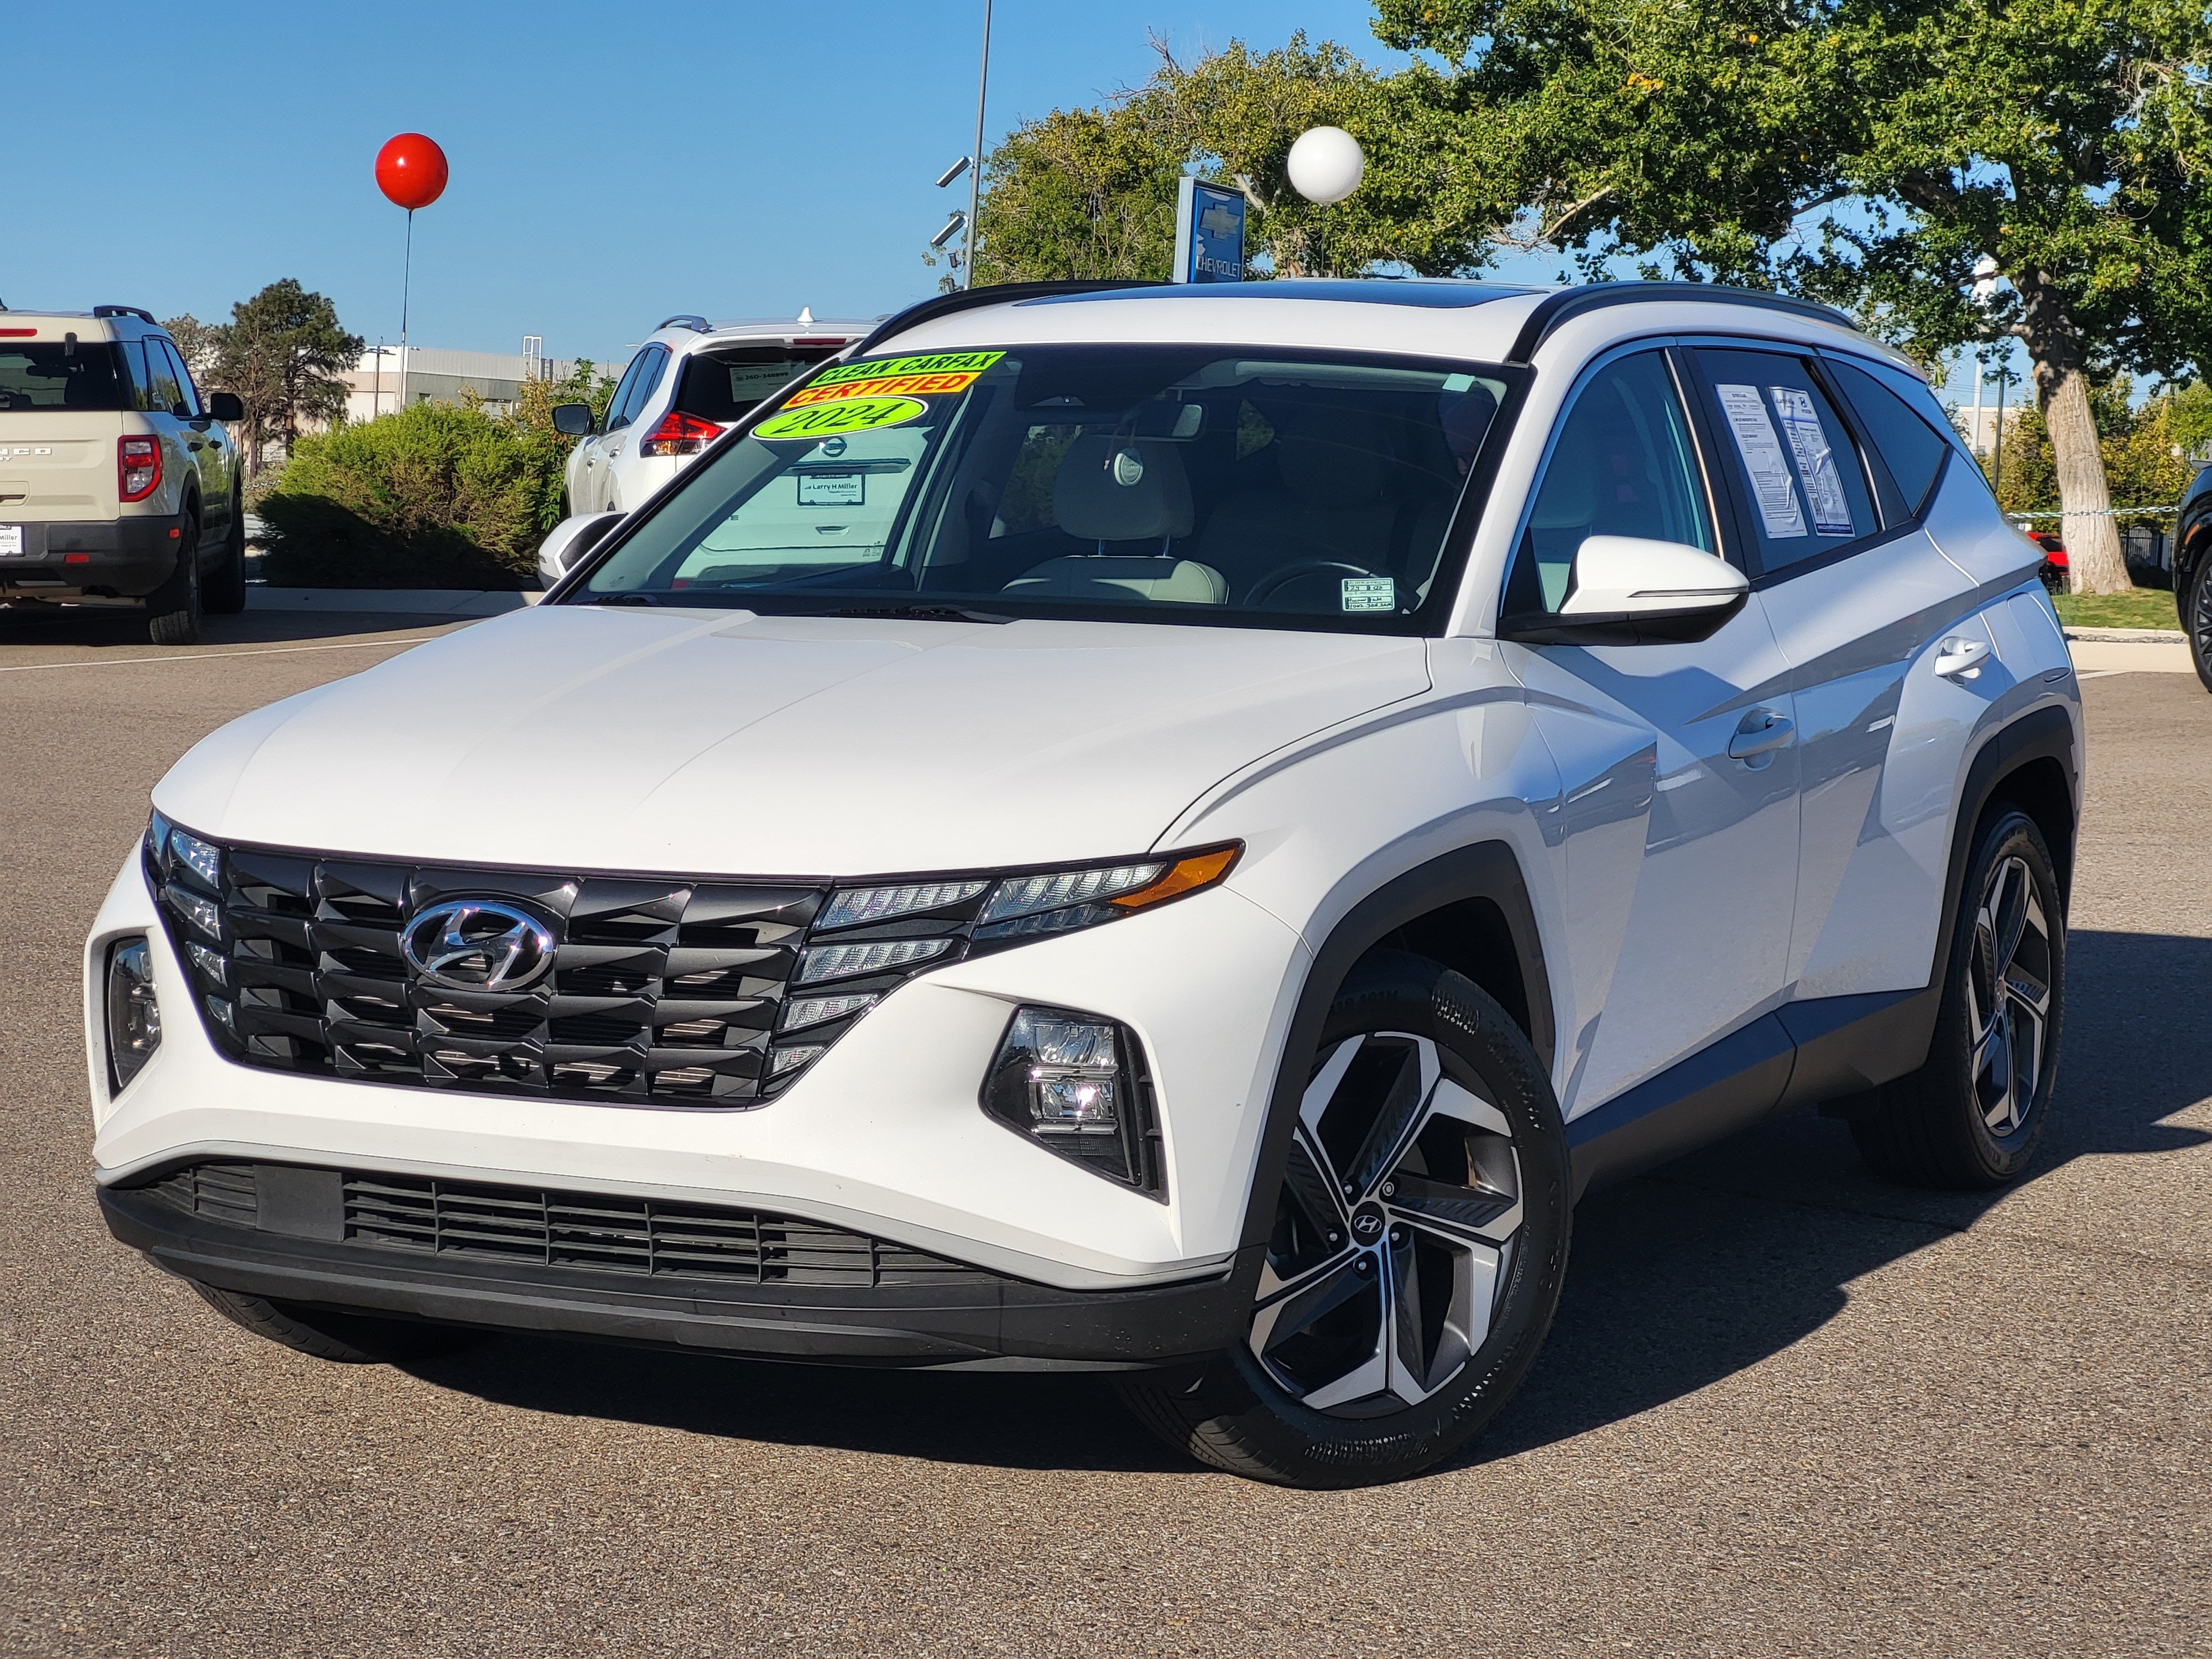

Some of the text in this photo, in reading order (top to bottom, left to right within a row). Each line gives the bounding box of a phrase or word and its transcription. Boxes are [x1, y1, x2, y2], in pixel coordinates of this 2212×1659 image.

[1196, 255, 1241, 278] CHEVROLET
[816, 354, 1000, 383] CLEAN CARFAX
[789, 375, 971, 405] CERTIFIED
[771, 402, 906, 434] 2024
